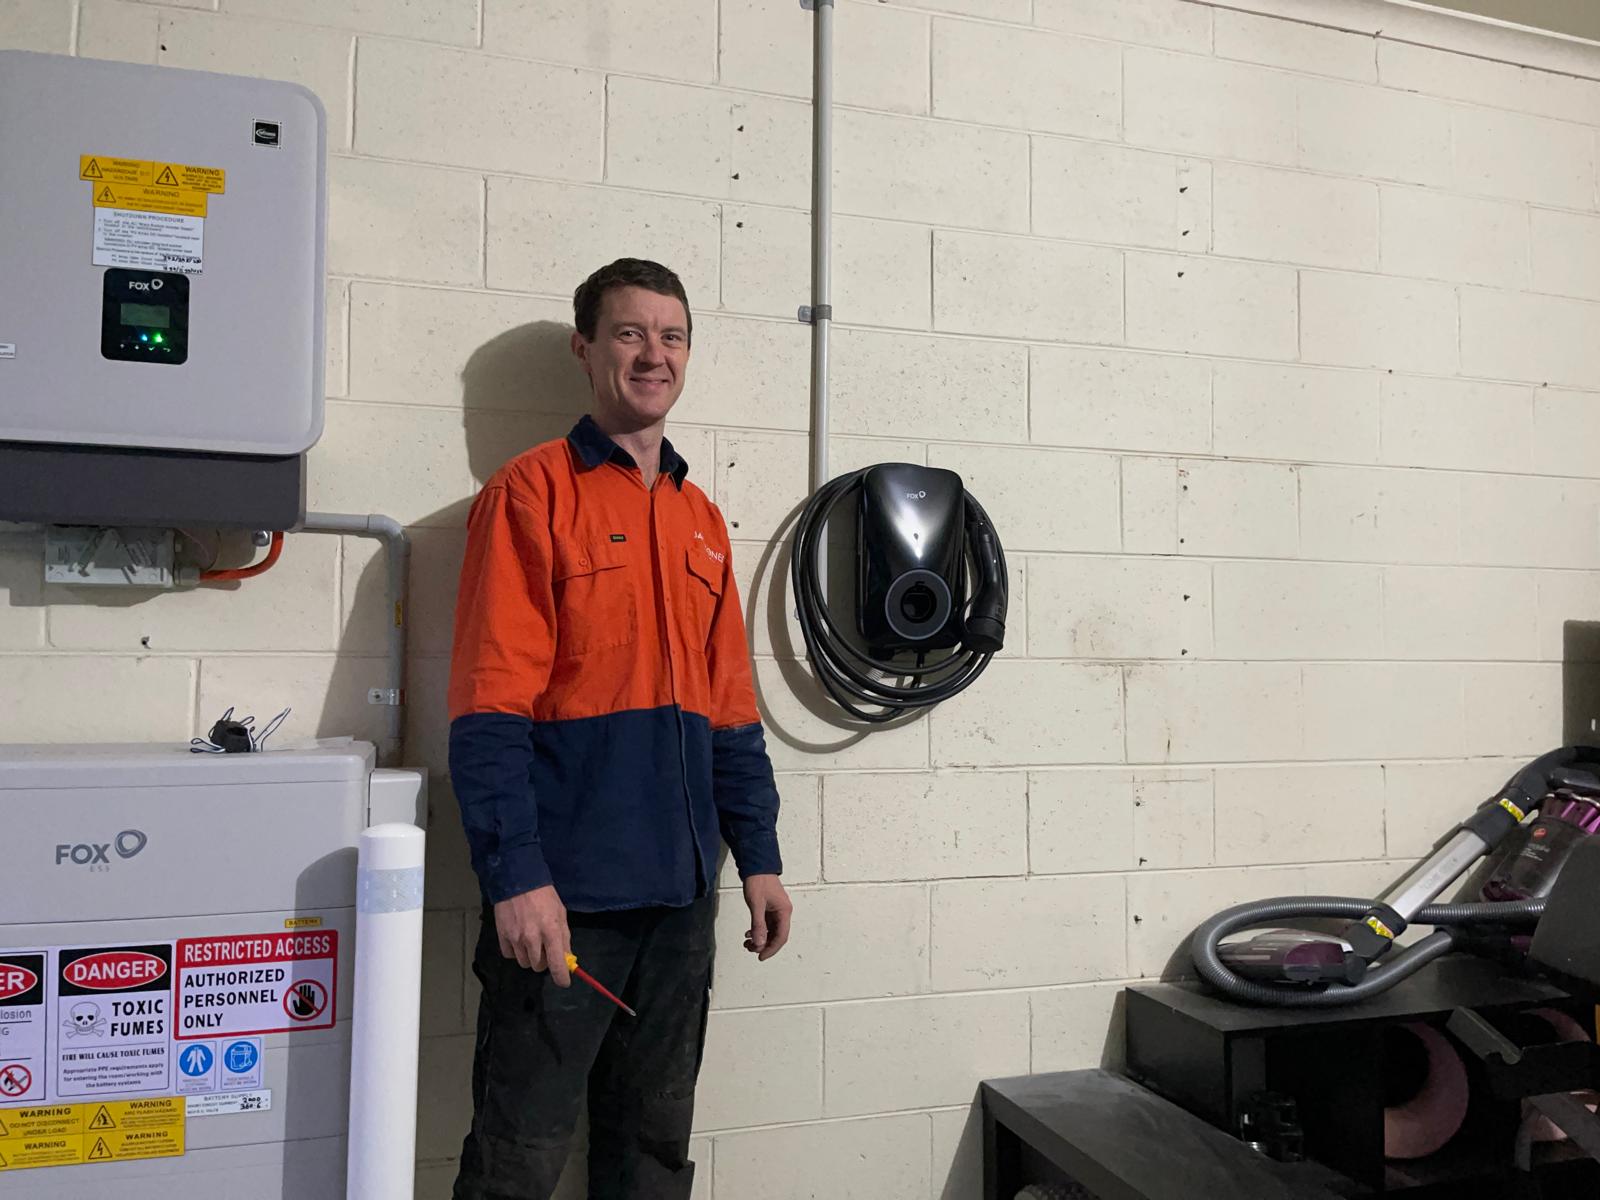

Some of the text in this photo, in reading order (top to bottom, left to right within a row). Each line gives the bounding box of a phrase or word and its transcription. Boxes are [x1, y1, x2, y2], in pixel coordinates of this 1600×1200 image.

[184, 166, 221, 176] WARNING
[143, 188, 180, 198] WARNING
[128, 281, 150, 291] FOX
[55, 844, 111, 865] FOX
[184, 935, 331, 963] RESTRICTED ACCESS
[73, 959, 158, 981] DANGER
[184, 968, 285, 988] AUTHORIZED
[184, 989, 278, 1009] PERSONNEL
[112, 999, 164, 1017] TOXIC
[184, 1013, 224, 1029] ONLY
[110, 1020, 164, 1037] FUMES
[62, 1047, 165, 1061] FIRE WILL CAUSE TOXIC FUMES
[63, 1066, 97, 1075] Appropriate
[110, 1063, 148, 1072] requirements
[129, 1099, 172, 1109] WARNING
[20, 1107, 72, 1118] WARNING
[126, 1131, 168, 1140] WARNING
[24, 1140, 66, 1150] WARNING
